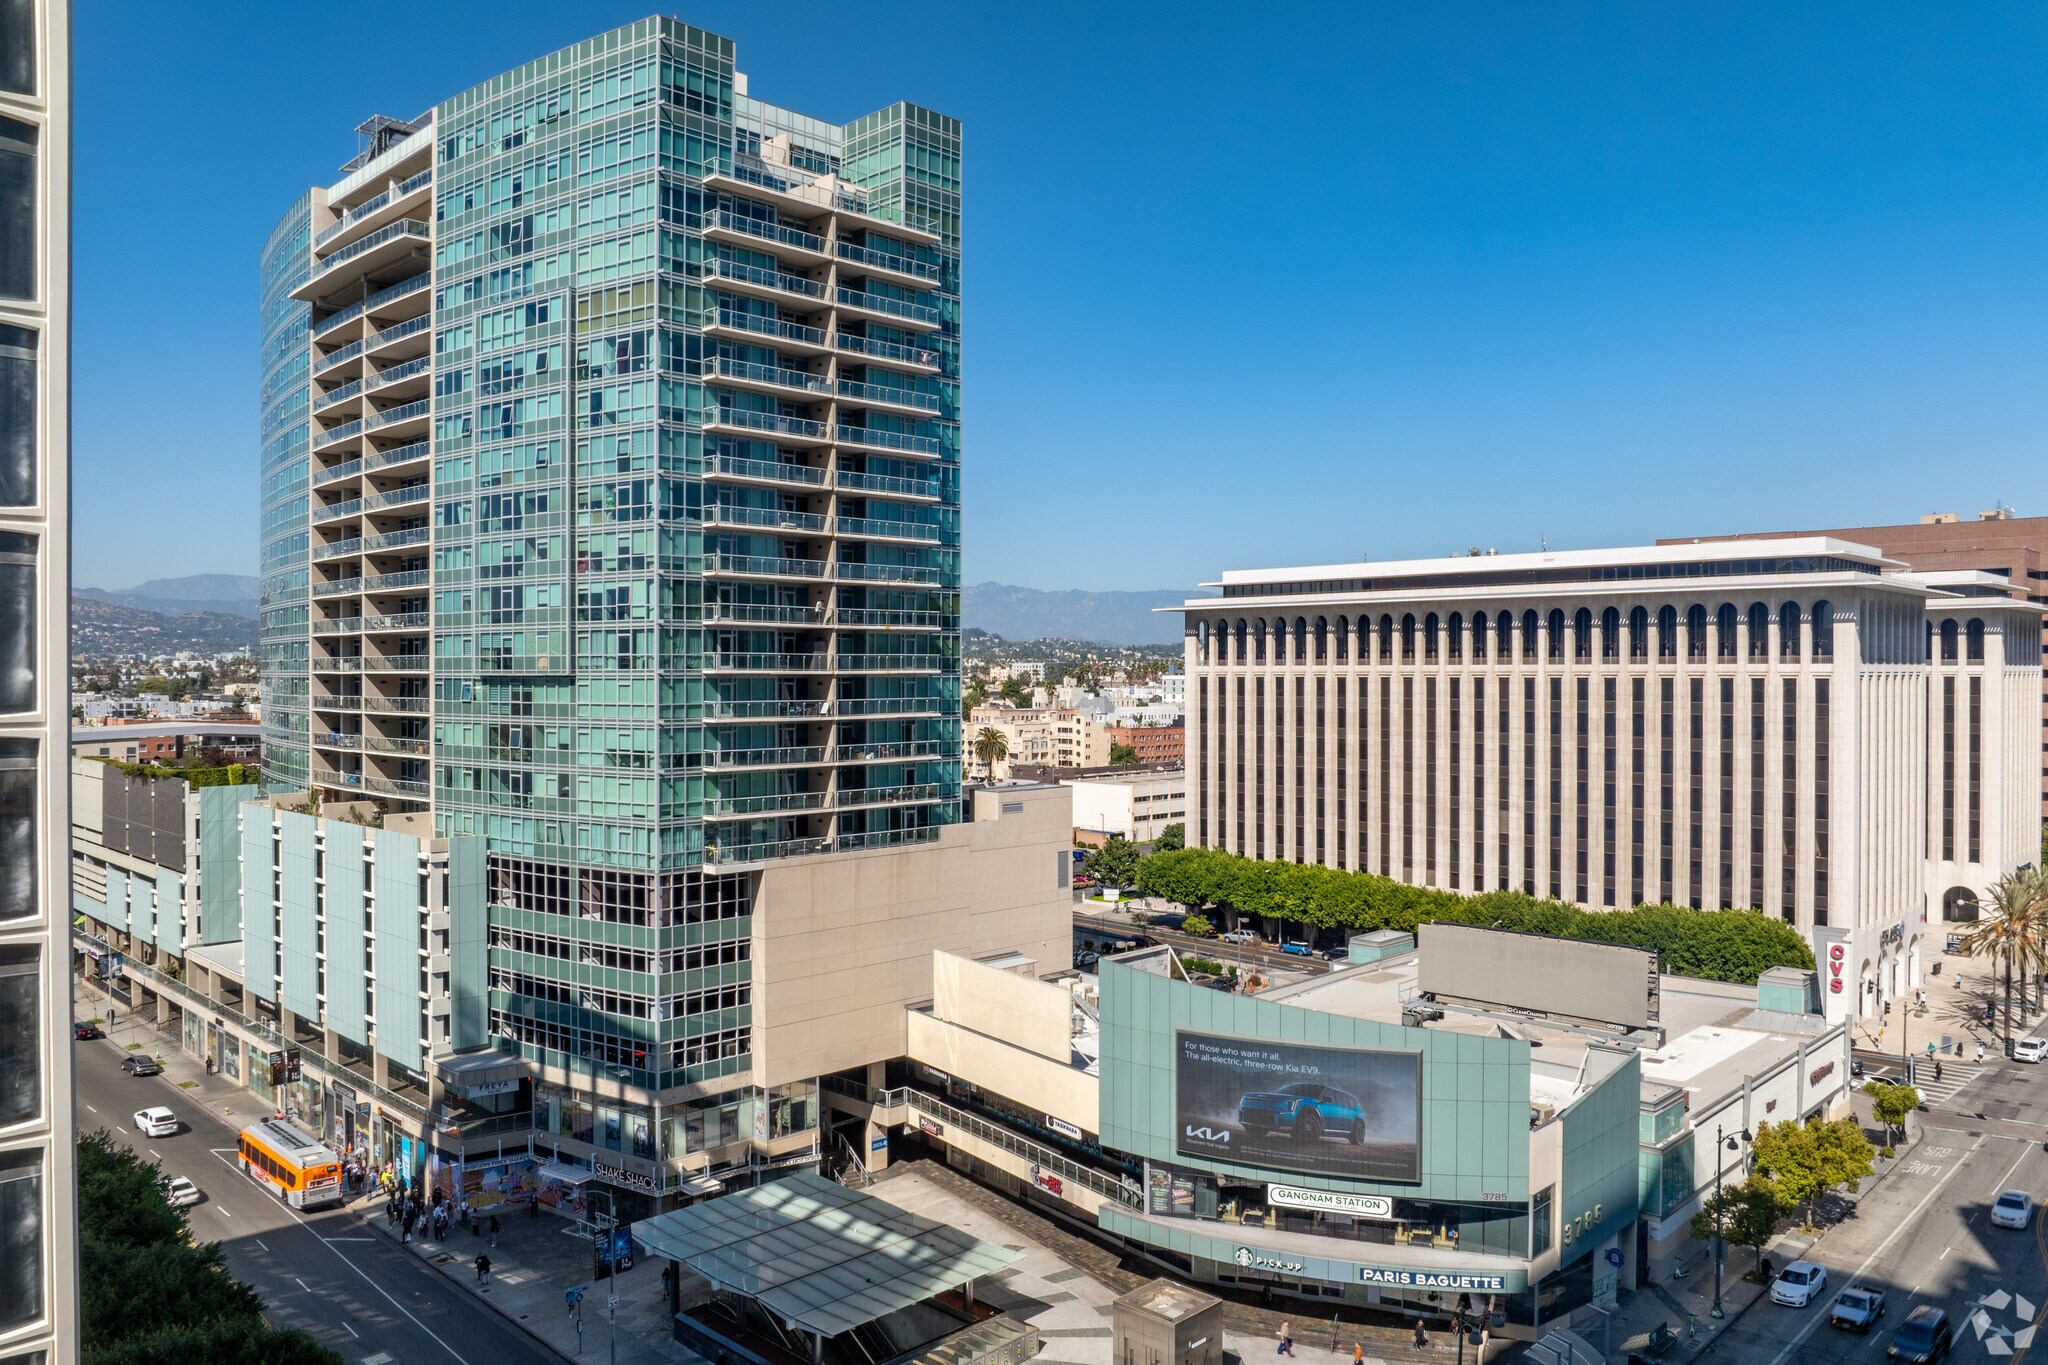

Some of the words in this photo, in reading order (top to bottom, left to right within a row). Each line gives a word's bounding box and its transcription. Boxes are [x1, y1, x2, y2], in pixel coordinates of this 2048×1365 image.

[1830, 944, 1844, 994] CVS
[1185, 1041, 1197, 1050] For
[1199, 1043, 1220, 1053] those
[1222, 1046, 1238, 1056] who
[1240, 1050, 1260, 1058] want
[1262, 1051, 1268, 1060] it
[1270, 1052, 1281, 1061] all.
[1185, 1050, 1200, 1060] The
[1200, 1052, 1242, 1067] all-electric,
[1244, 1059, 1284, 1071] three-row
[1286, 1064, 1299, 1072] Kia
[1301, 1065, 1320, 1075] EV9.
[480, 1081, 509, 1090] FREYA
[1923, 1146, 1952, 1158] BUS
[596, 1163, 624, 1182] SHAKE
[626, 1171, 656, 1190] SHACK
[1902, 1160, 1942, 1176] LANE
[1278, 1190, 1332, 1204] GANGNAM
[1336, 1196, 1380, 1209] STATION
[1482, 1193, 1508, 1201] 3785
[1256, 1256, 1282, 1268] PICK
[1288, 1262, 1302, 1271] UP
[1364, 1269, 1410, 1284] PARIS
[1416, 1274, 1502, 1289] BAGUETTE
